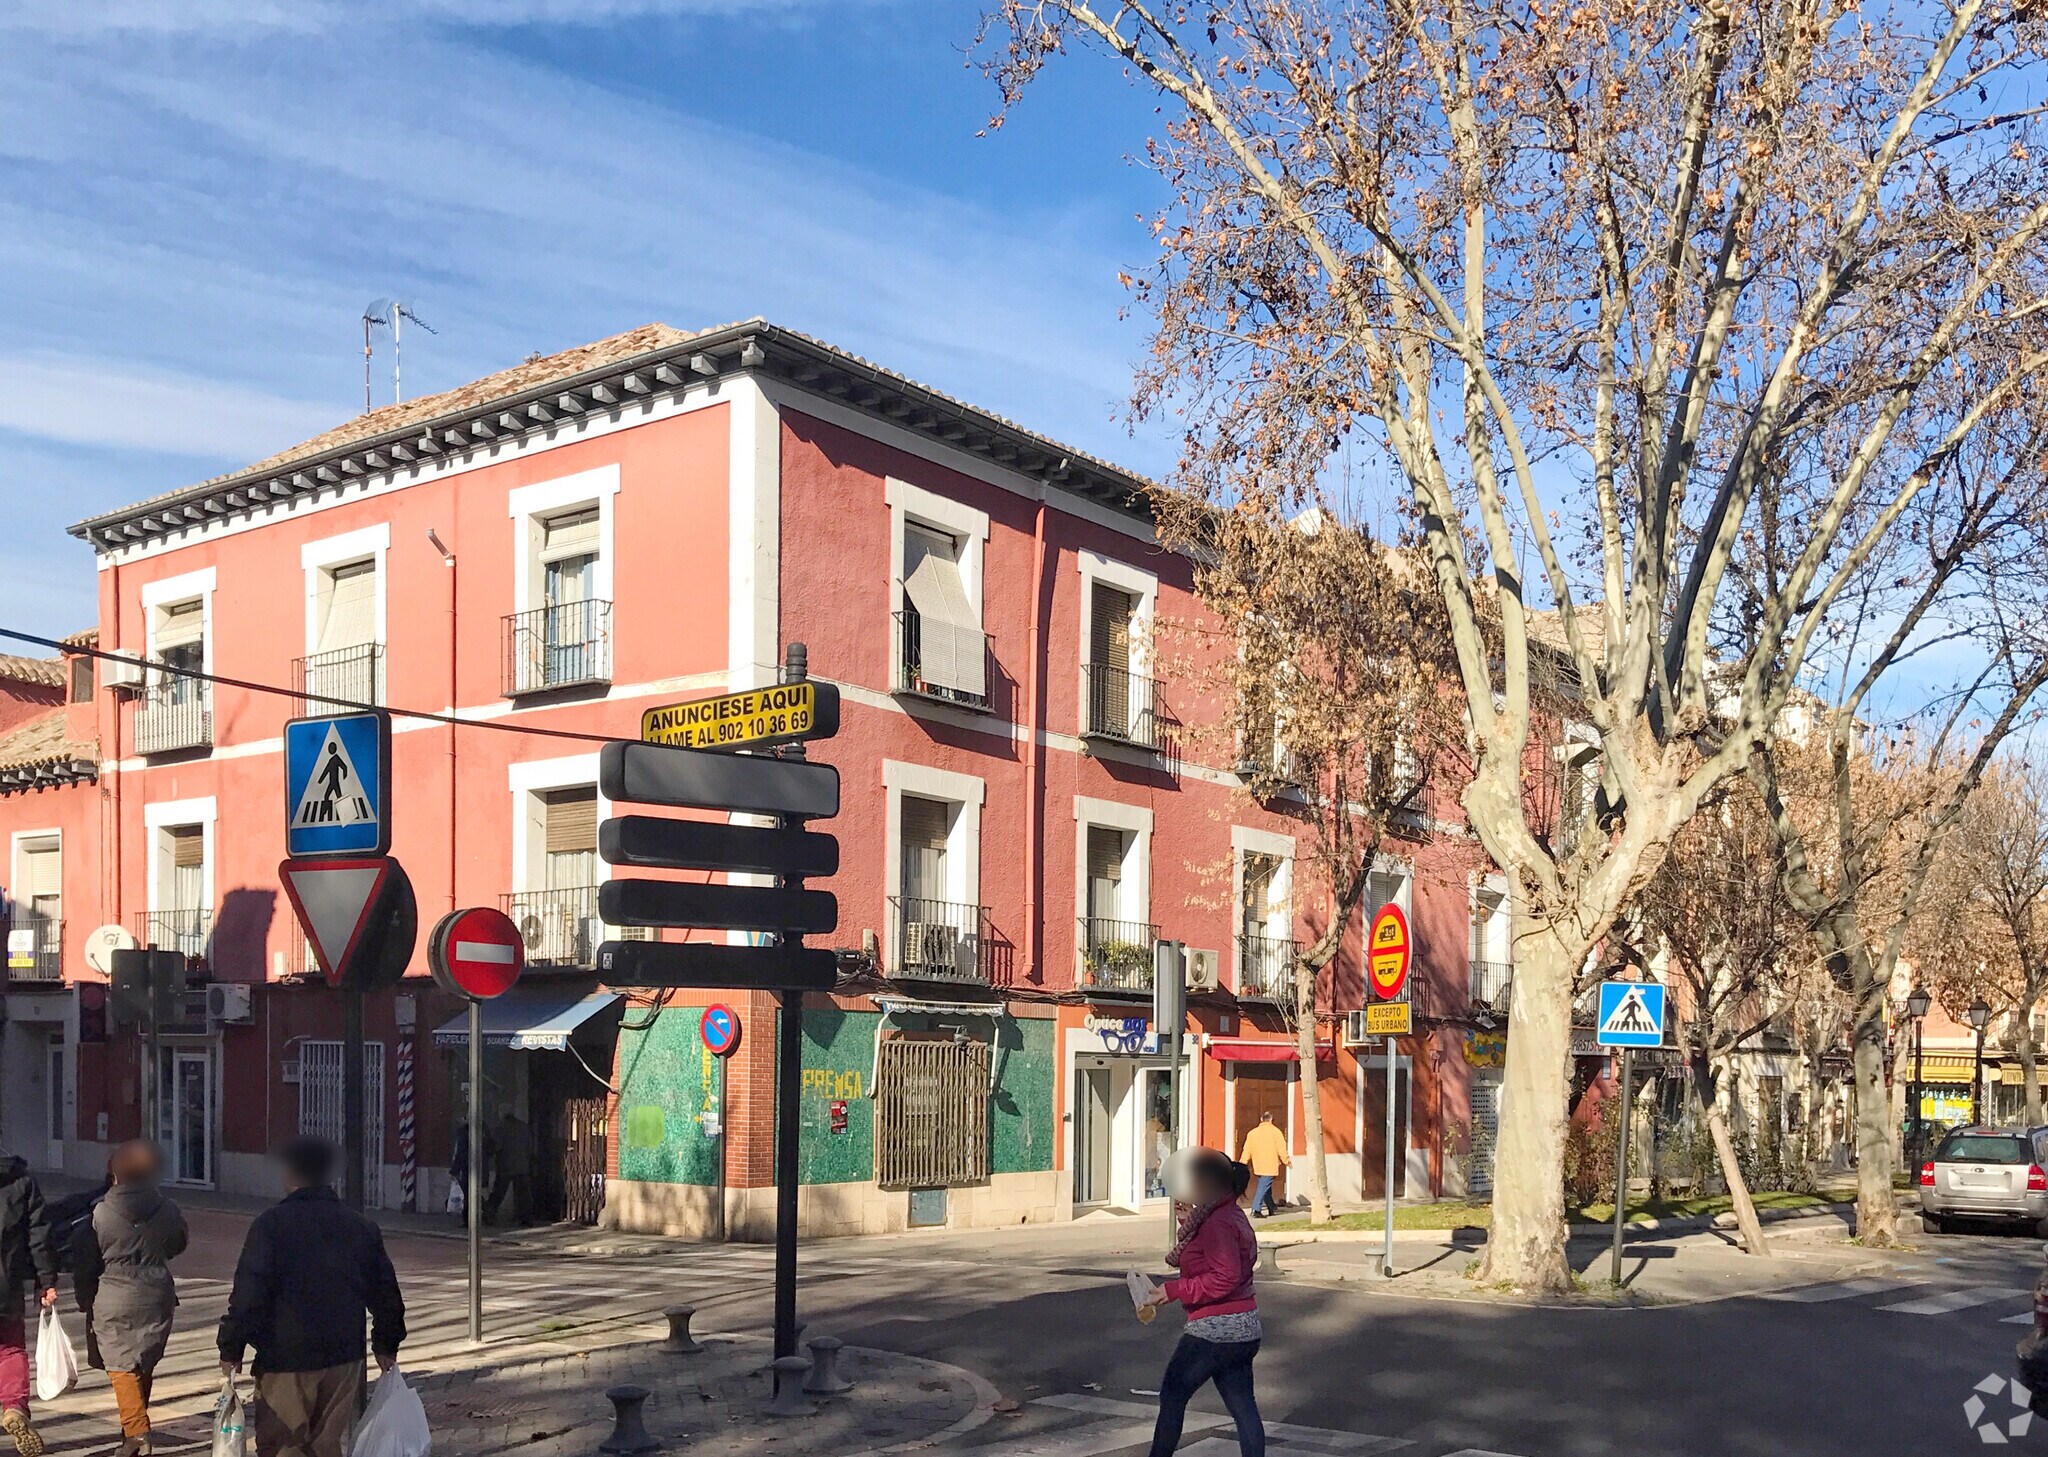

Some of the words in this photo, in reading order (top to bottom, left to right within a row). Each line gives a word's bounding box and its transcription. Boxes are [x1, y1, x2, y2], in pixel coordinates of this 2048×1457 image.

[649, 695, 754, 732] ANUNCIESE
[759, 687, 807, 712] AQUI
[697, 728, 714, 745] AL
[718, 721, 743, 742] 902
[748, 717, 764, 737] 10
[769, 714, 786, 734] 36
[790, 710, 809, 730] 69
[1373, 1007, 1401, 1018] EXCEPTO
[1367, 1020, 1380, 1031] BUS
[1381, 1019, 1407, 1030] URBANO
[521, 1034, 563, 1046] REVISTAS
[802, 1069, 863, 1100] PRENSA
